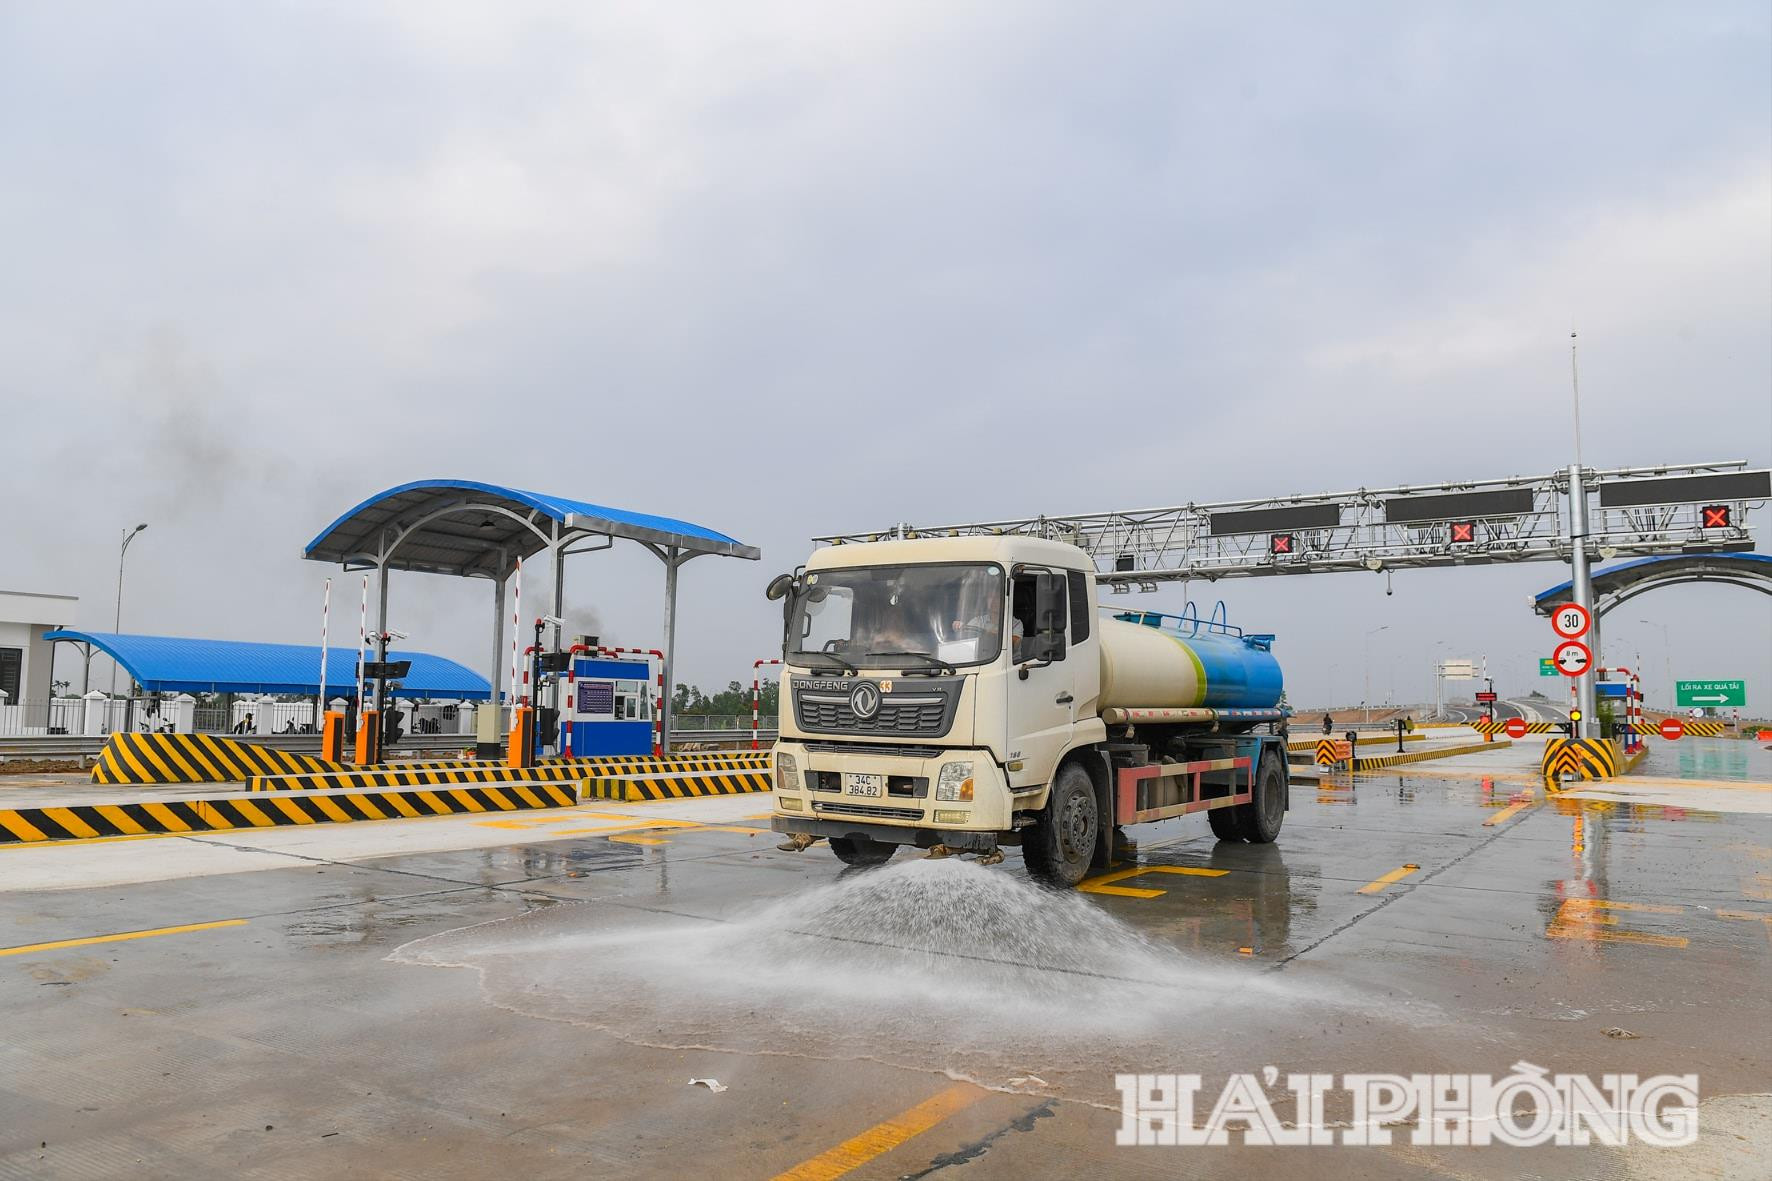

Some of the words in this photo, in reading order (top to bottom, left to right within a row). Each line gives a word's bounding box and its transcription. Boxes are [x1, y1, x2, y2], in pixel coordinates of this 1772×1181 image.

[1564, 614, 1579, 628] 30
[792, 680, 848, 690] DONGFENG
[879, 680, 892, 693] 33
[855, 775, 871, 785] 34C
[849, 784, 877, 796] 384.82
